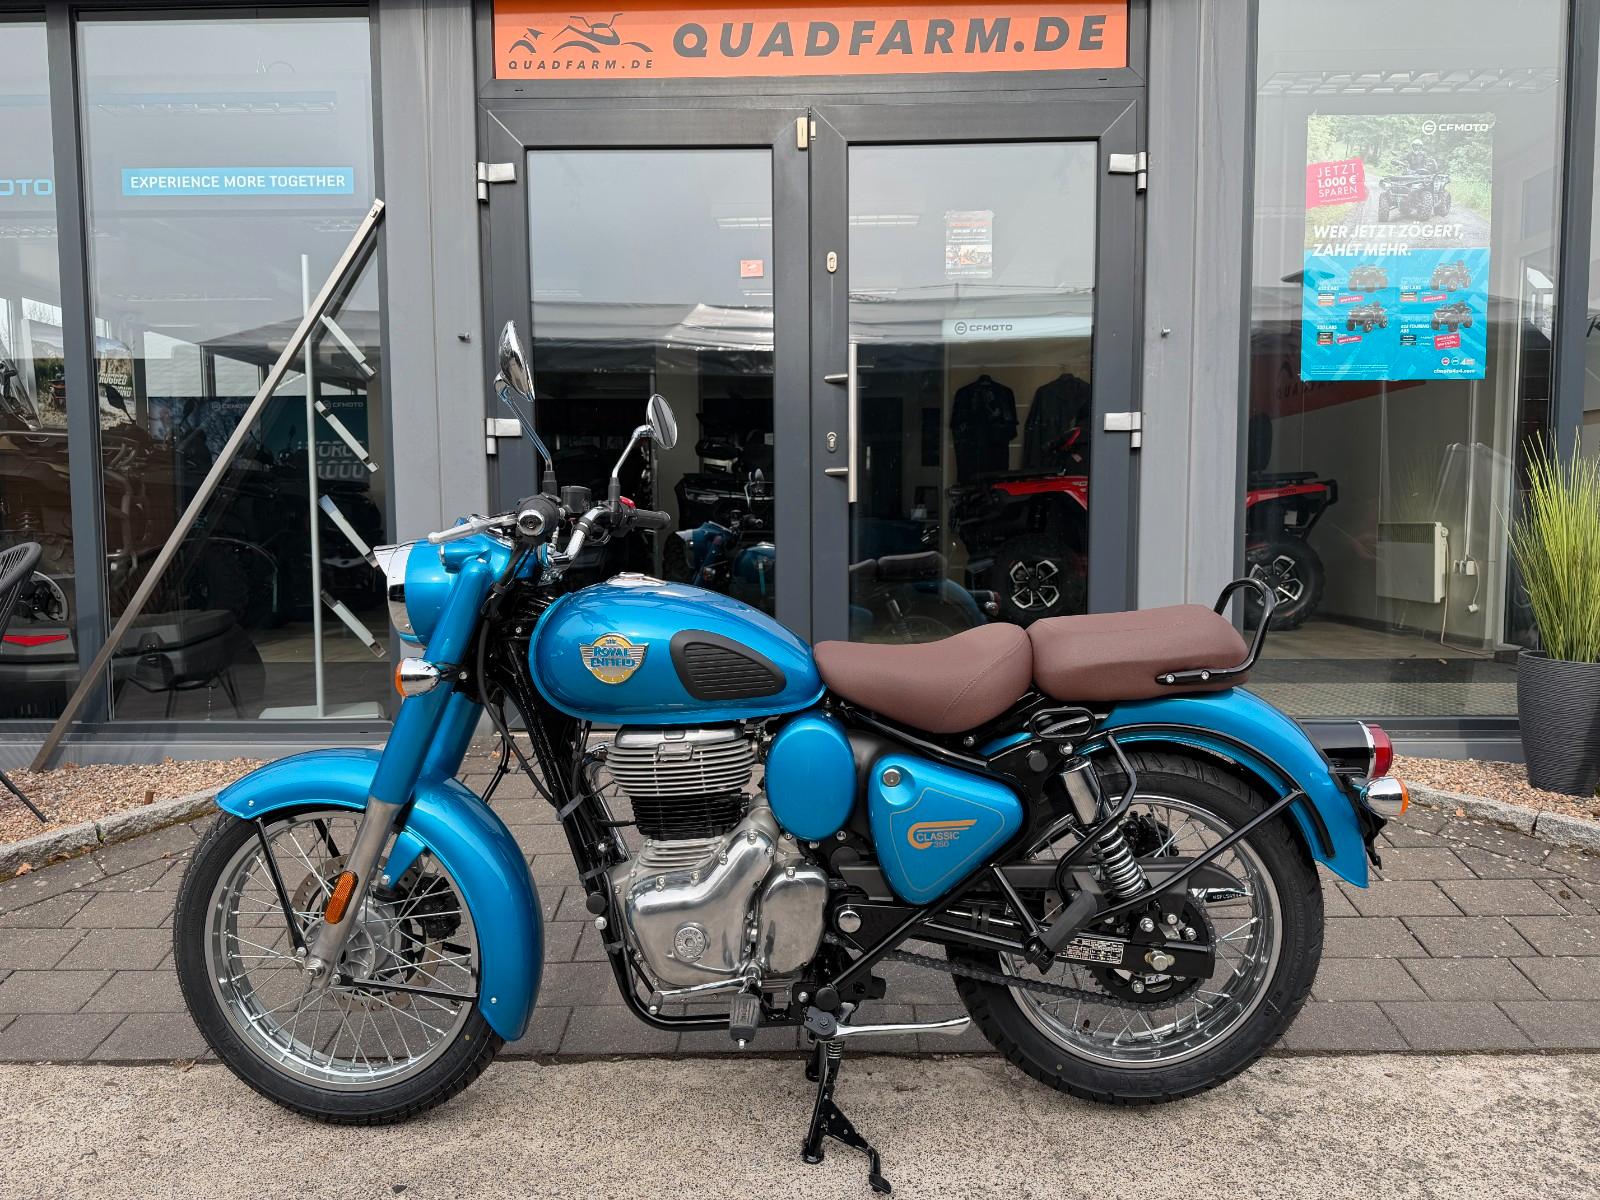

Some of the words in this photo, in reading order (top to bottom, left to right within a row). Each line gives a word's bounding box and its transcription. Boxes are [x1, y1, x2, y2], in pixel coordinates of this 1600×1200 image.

[671, 14, 1107, 59] QUADFARM.DE
[508, 59, 653, 71] QUADFARM.DE
[1438, 123, 1489, 132] CFMOTO
[1317, 163, 1357, 178] JETZT
[130, 175, 220, 189] EXPERIENCE
[224, 175, 265, 188] MORE
[269, 174, 345, 188] TOGETHER
[1318, 185, 1358, 198] SPAREN
[1313, 224, 1348, 239] WER
[1349, 224, 1394, 238] JETZT
[1395, 220, 1464, 240] ZÖGERT,
[1363, 242, 1412, 257] MEHR.
[968, 323, 1013, 332] CFMOTO
[592, 646, 630, 657] ROYAL
[590, 657, 636, 667] ENFIELD
[916, 831, 960, 842] CLASSIC
